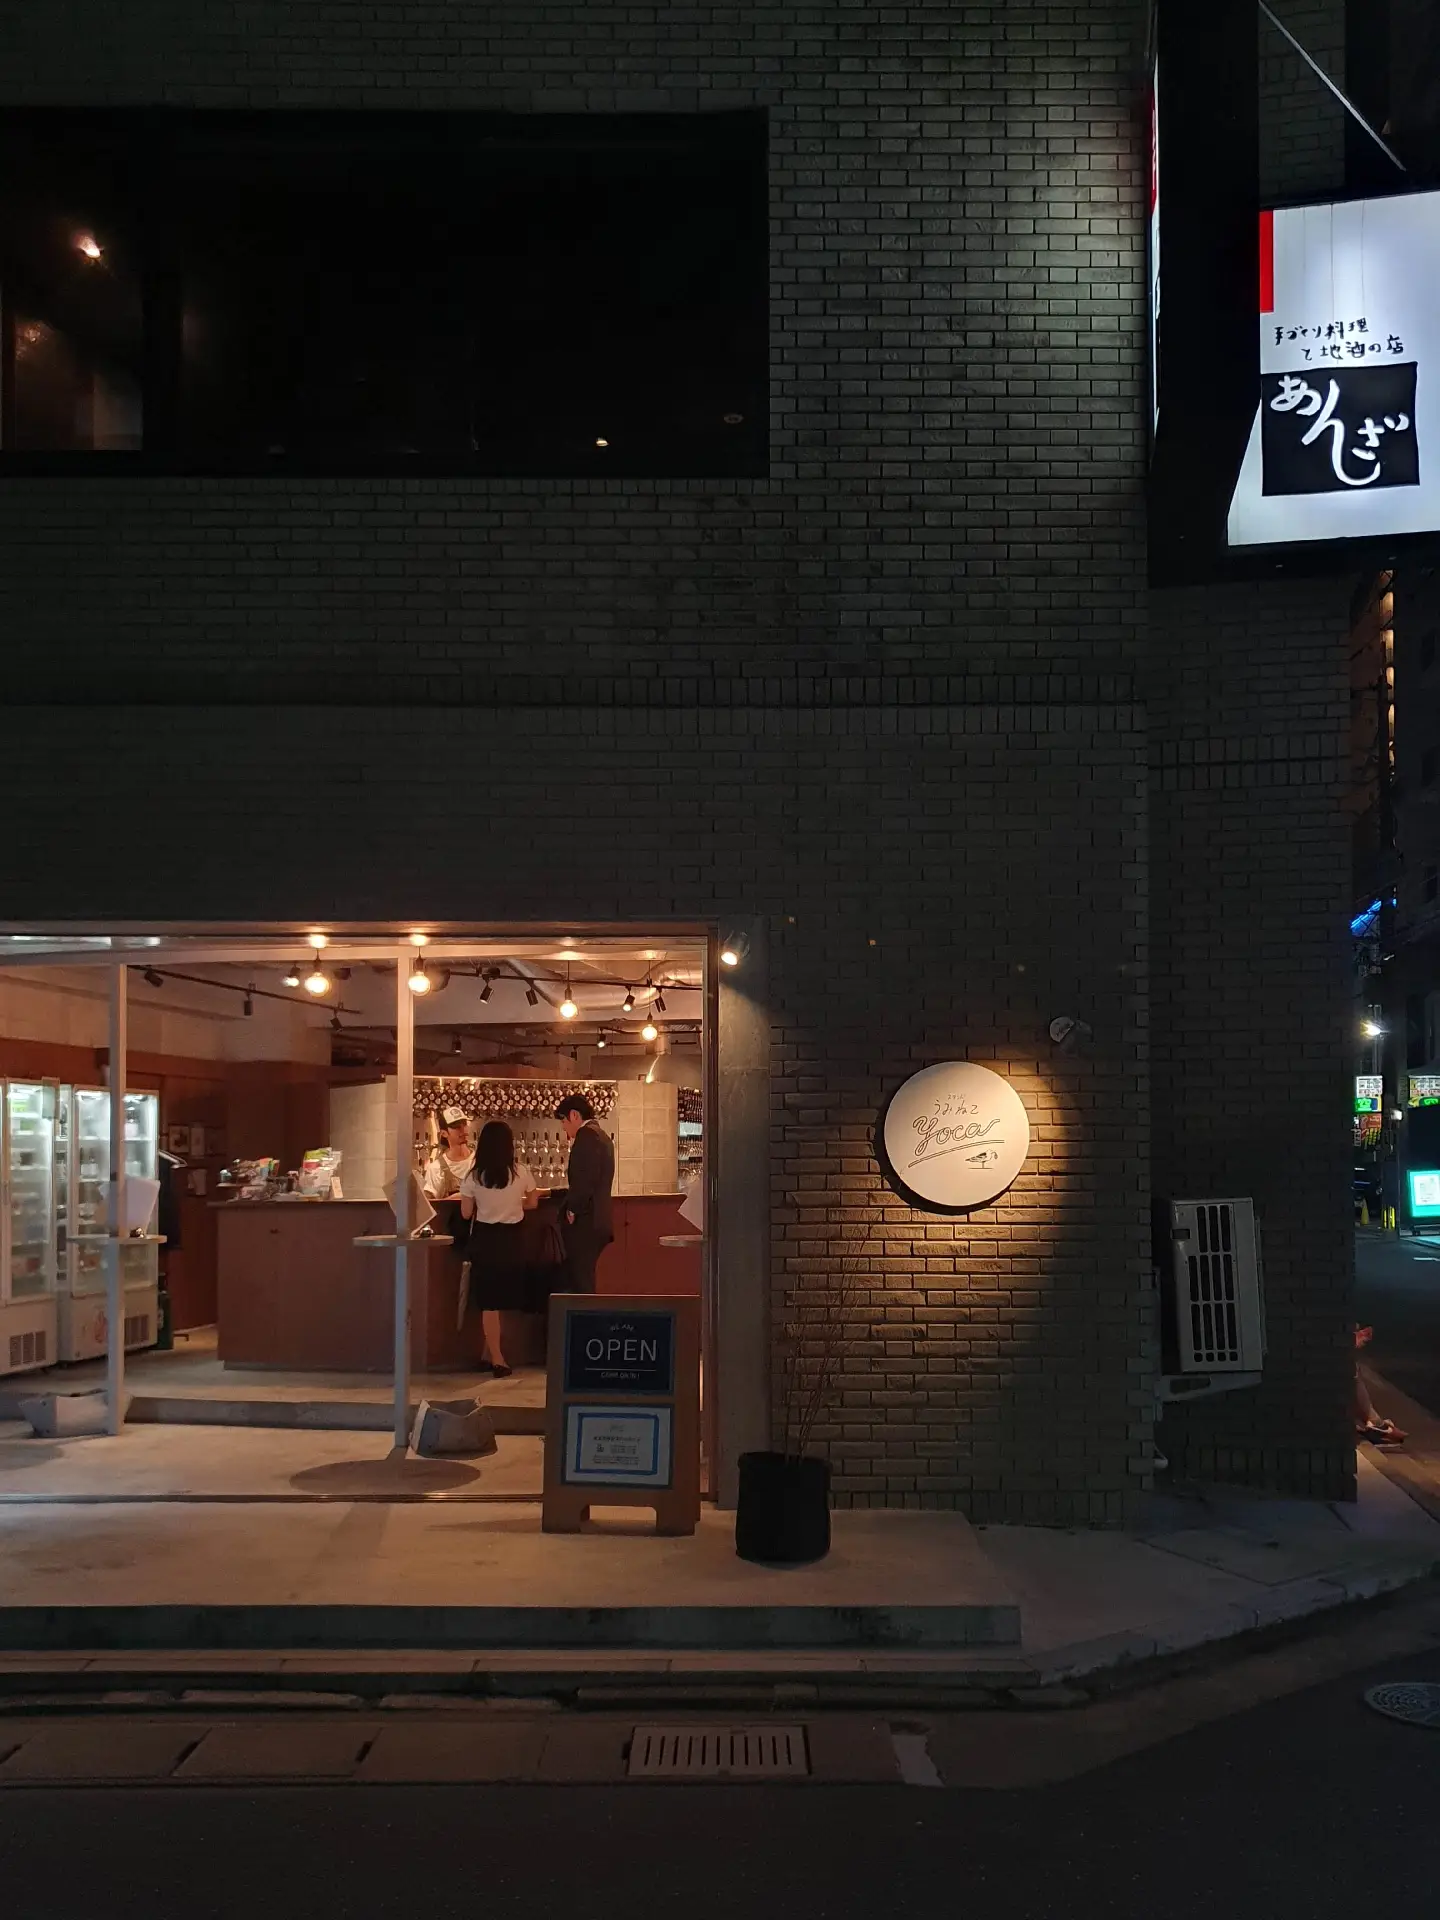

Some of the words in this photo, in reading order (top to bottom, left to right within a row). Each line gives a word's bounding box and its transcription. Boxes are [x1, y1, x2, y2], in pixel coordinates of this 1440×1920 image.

[933, 1099, 979, 1116] うみねこ
[586, 1338, 657, 1361] OPEN
